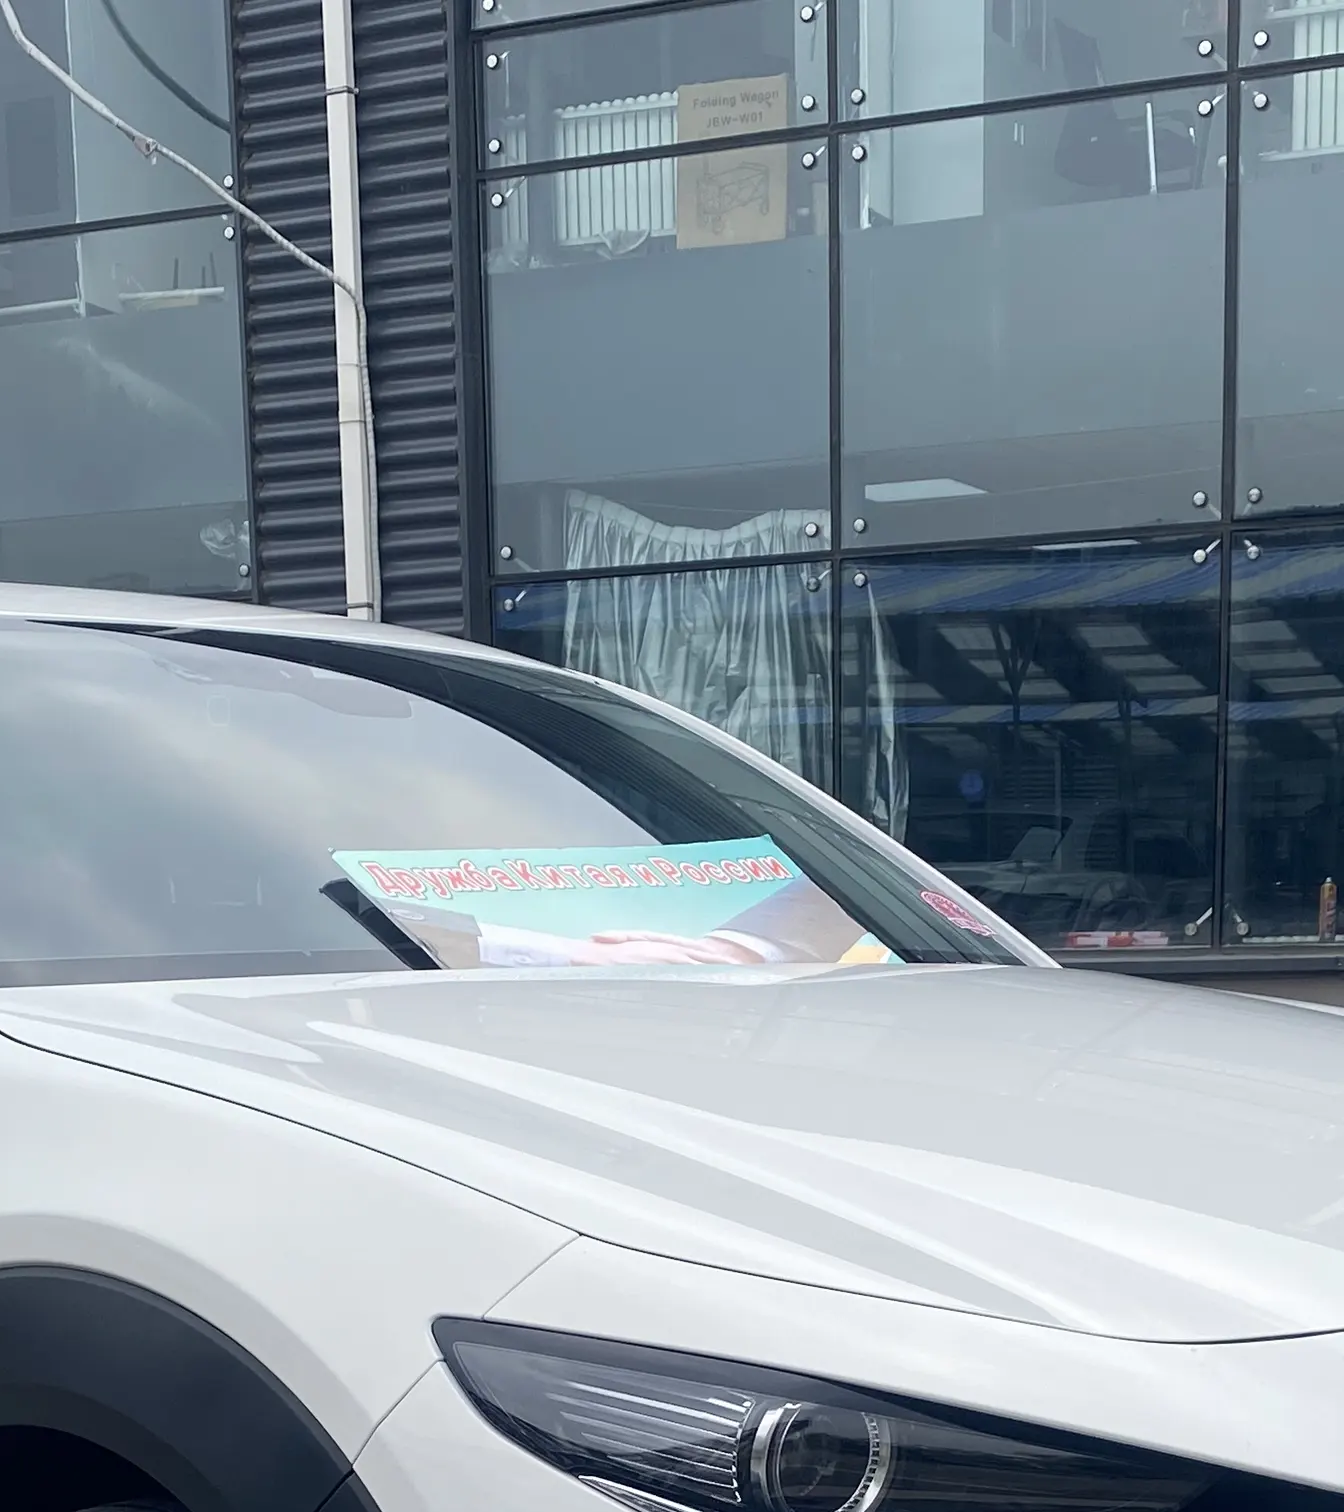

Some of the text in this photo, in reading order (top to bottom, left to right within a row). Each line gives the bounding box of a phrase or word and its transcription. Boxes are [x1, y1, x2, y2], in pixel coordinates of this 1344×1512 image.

[693, 90, 779, 110] Folding Wagon
[706, 111, 763, 128] JBW-W01
[359, 859, 525, 899] Дружба
[503, 858, 639, 891] Китая
[649, 856, 794, 886] России
